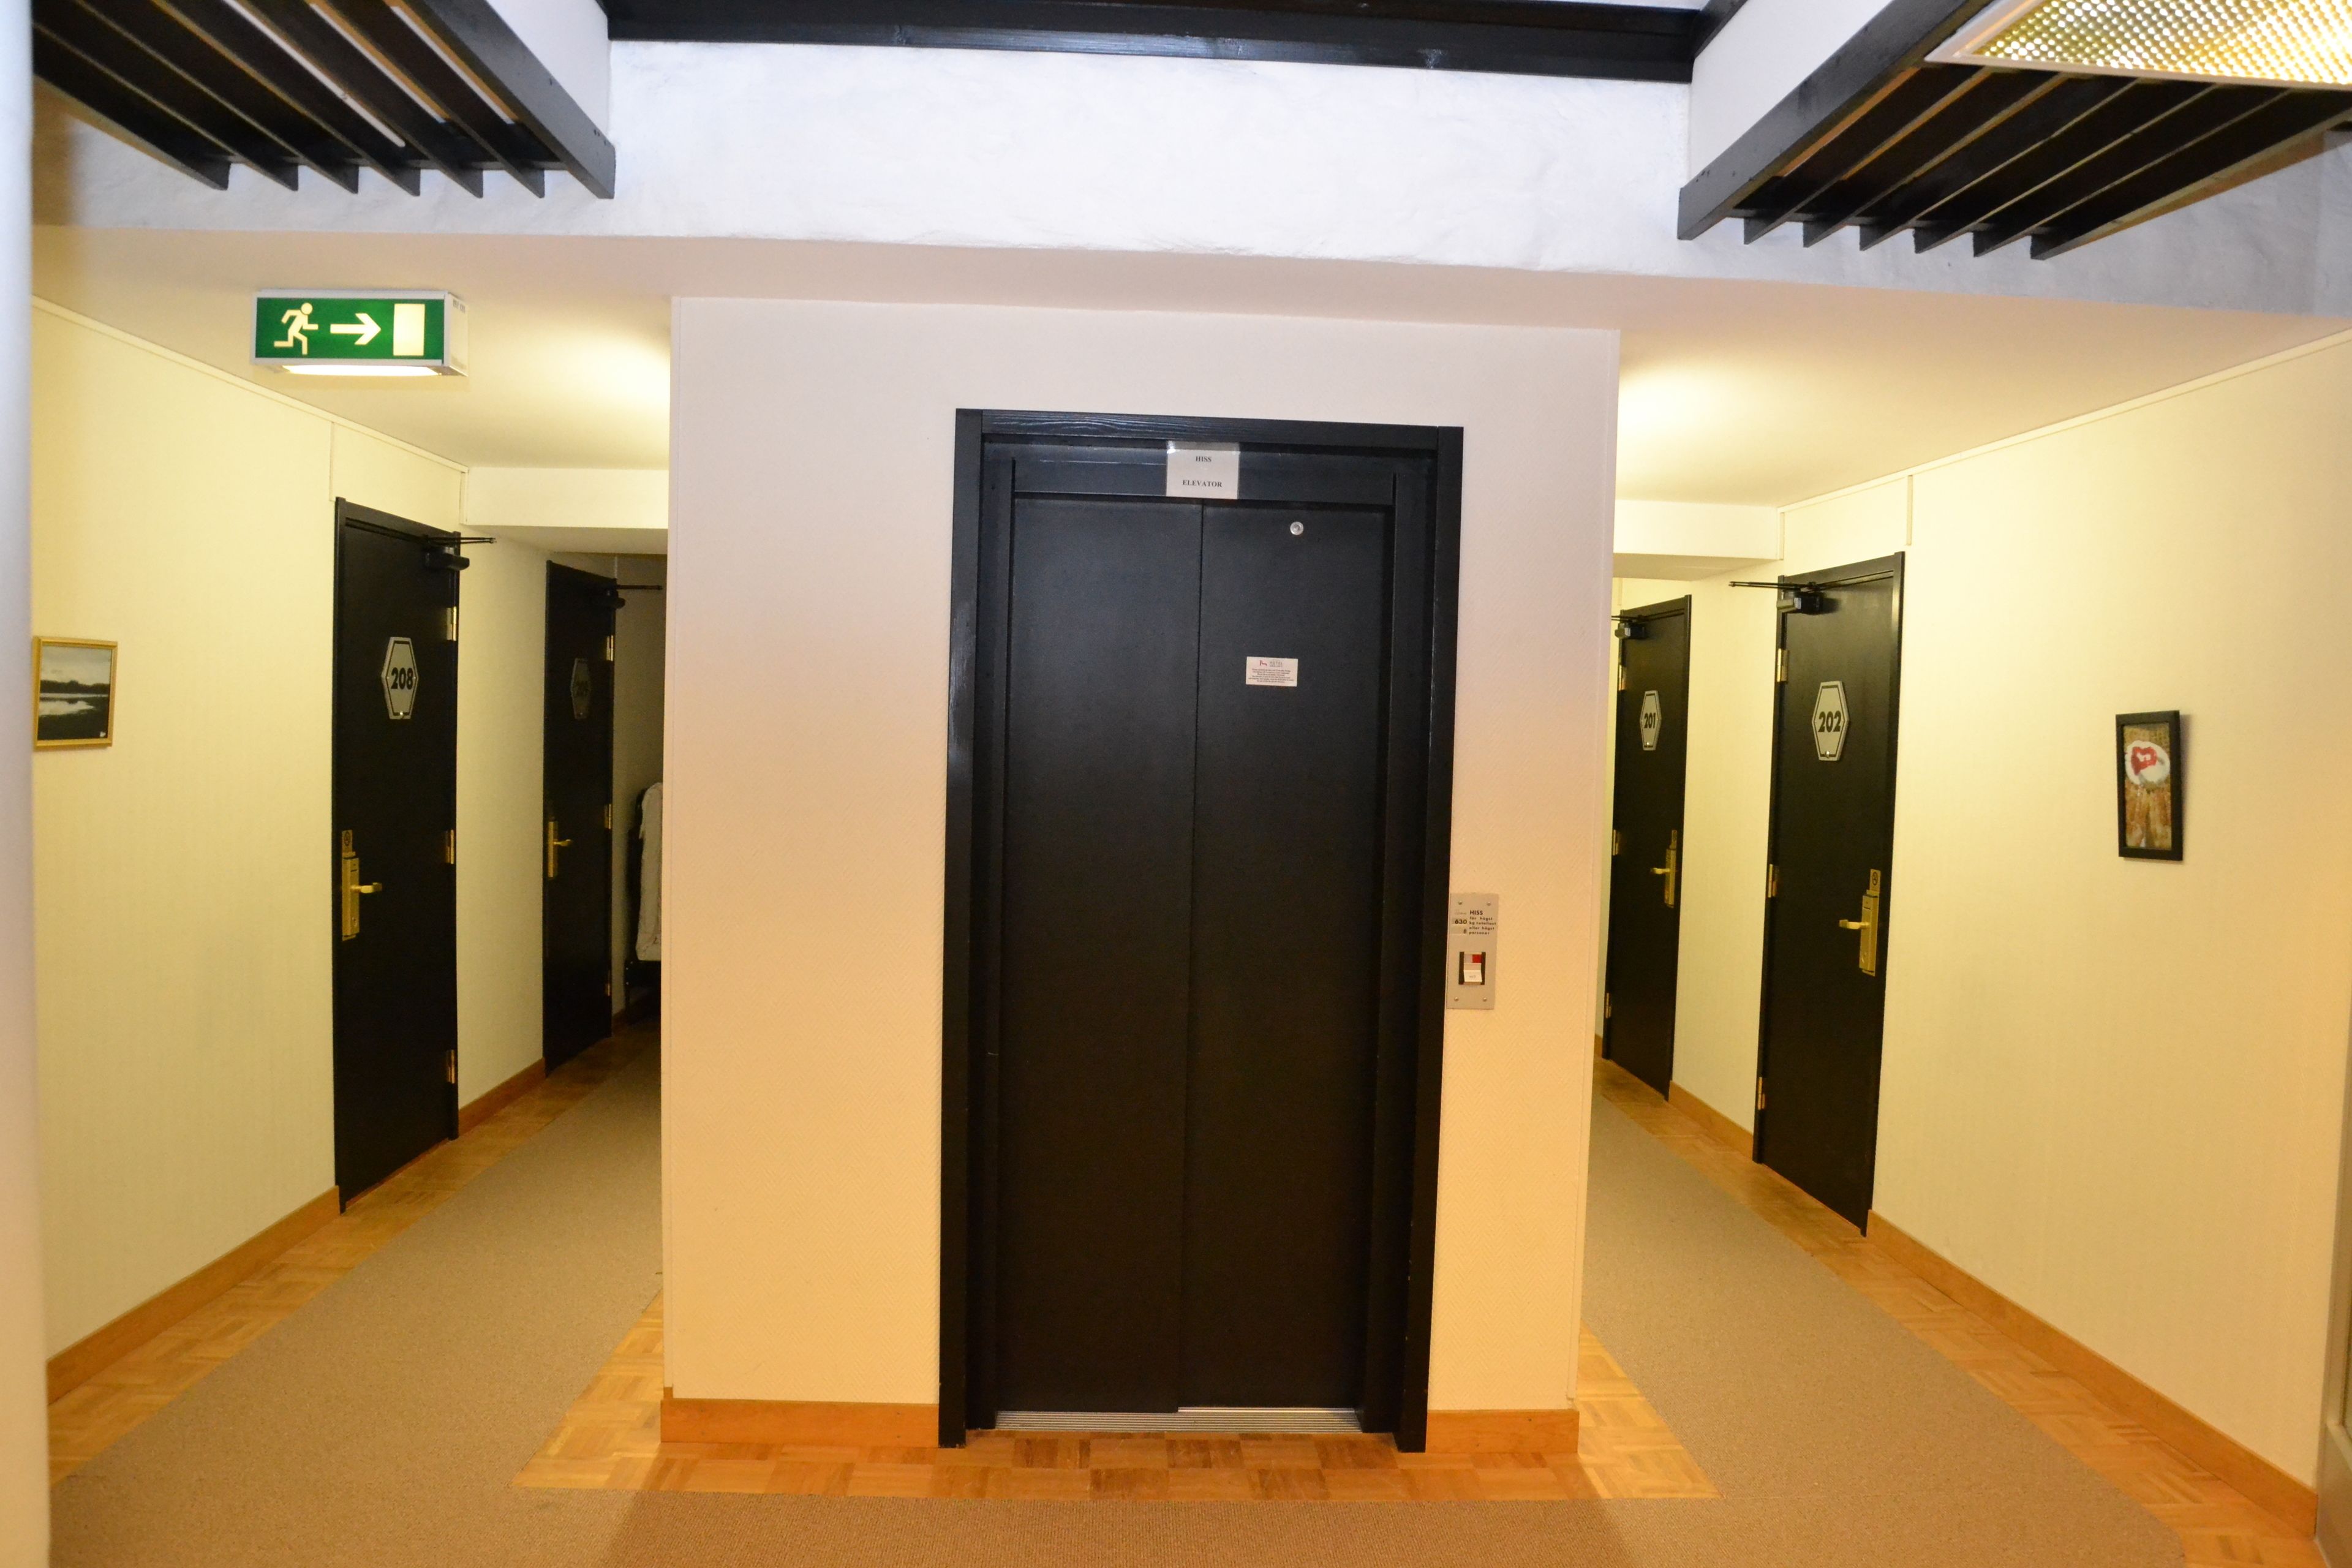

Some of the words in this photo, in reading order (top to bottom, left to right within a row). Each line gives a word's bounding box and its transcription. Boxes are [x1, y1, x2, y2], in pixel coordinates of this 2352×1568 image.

[390, 667, 413, 690] 208
[1643, 712, 1656, 729] 201
[1817, 710, 1842, 733] 202
